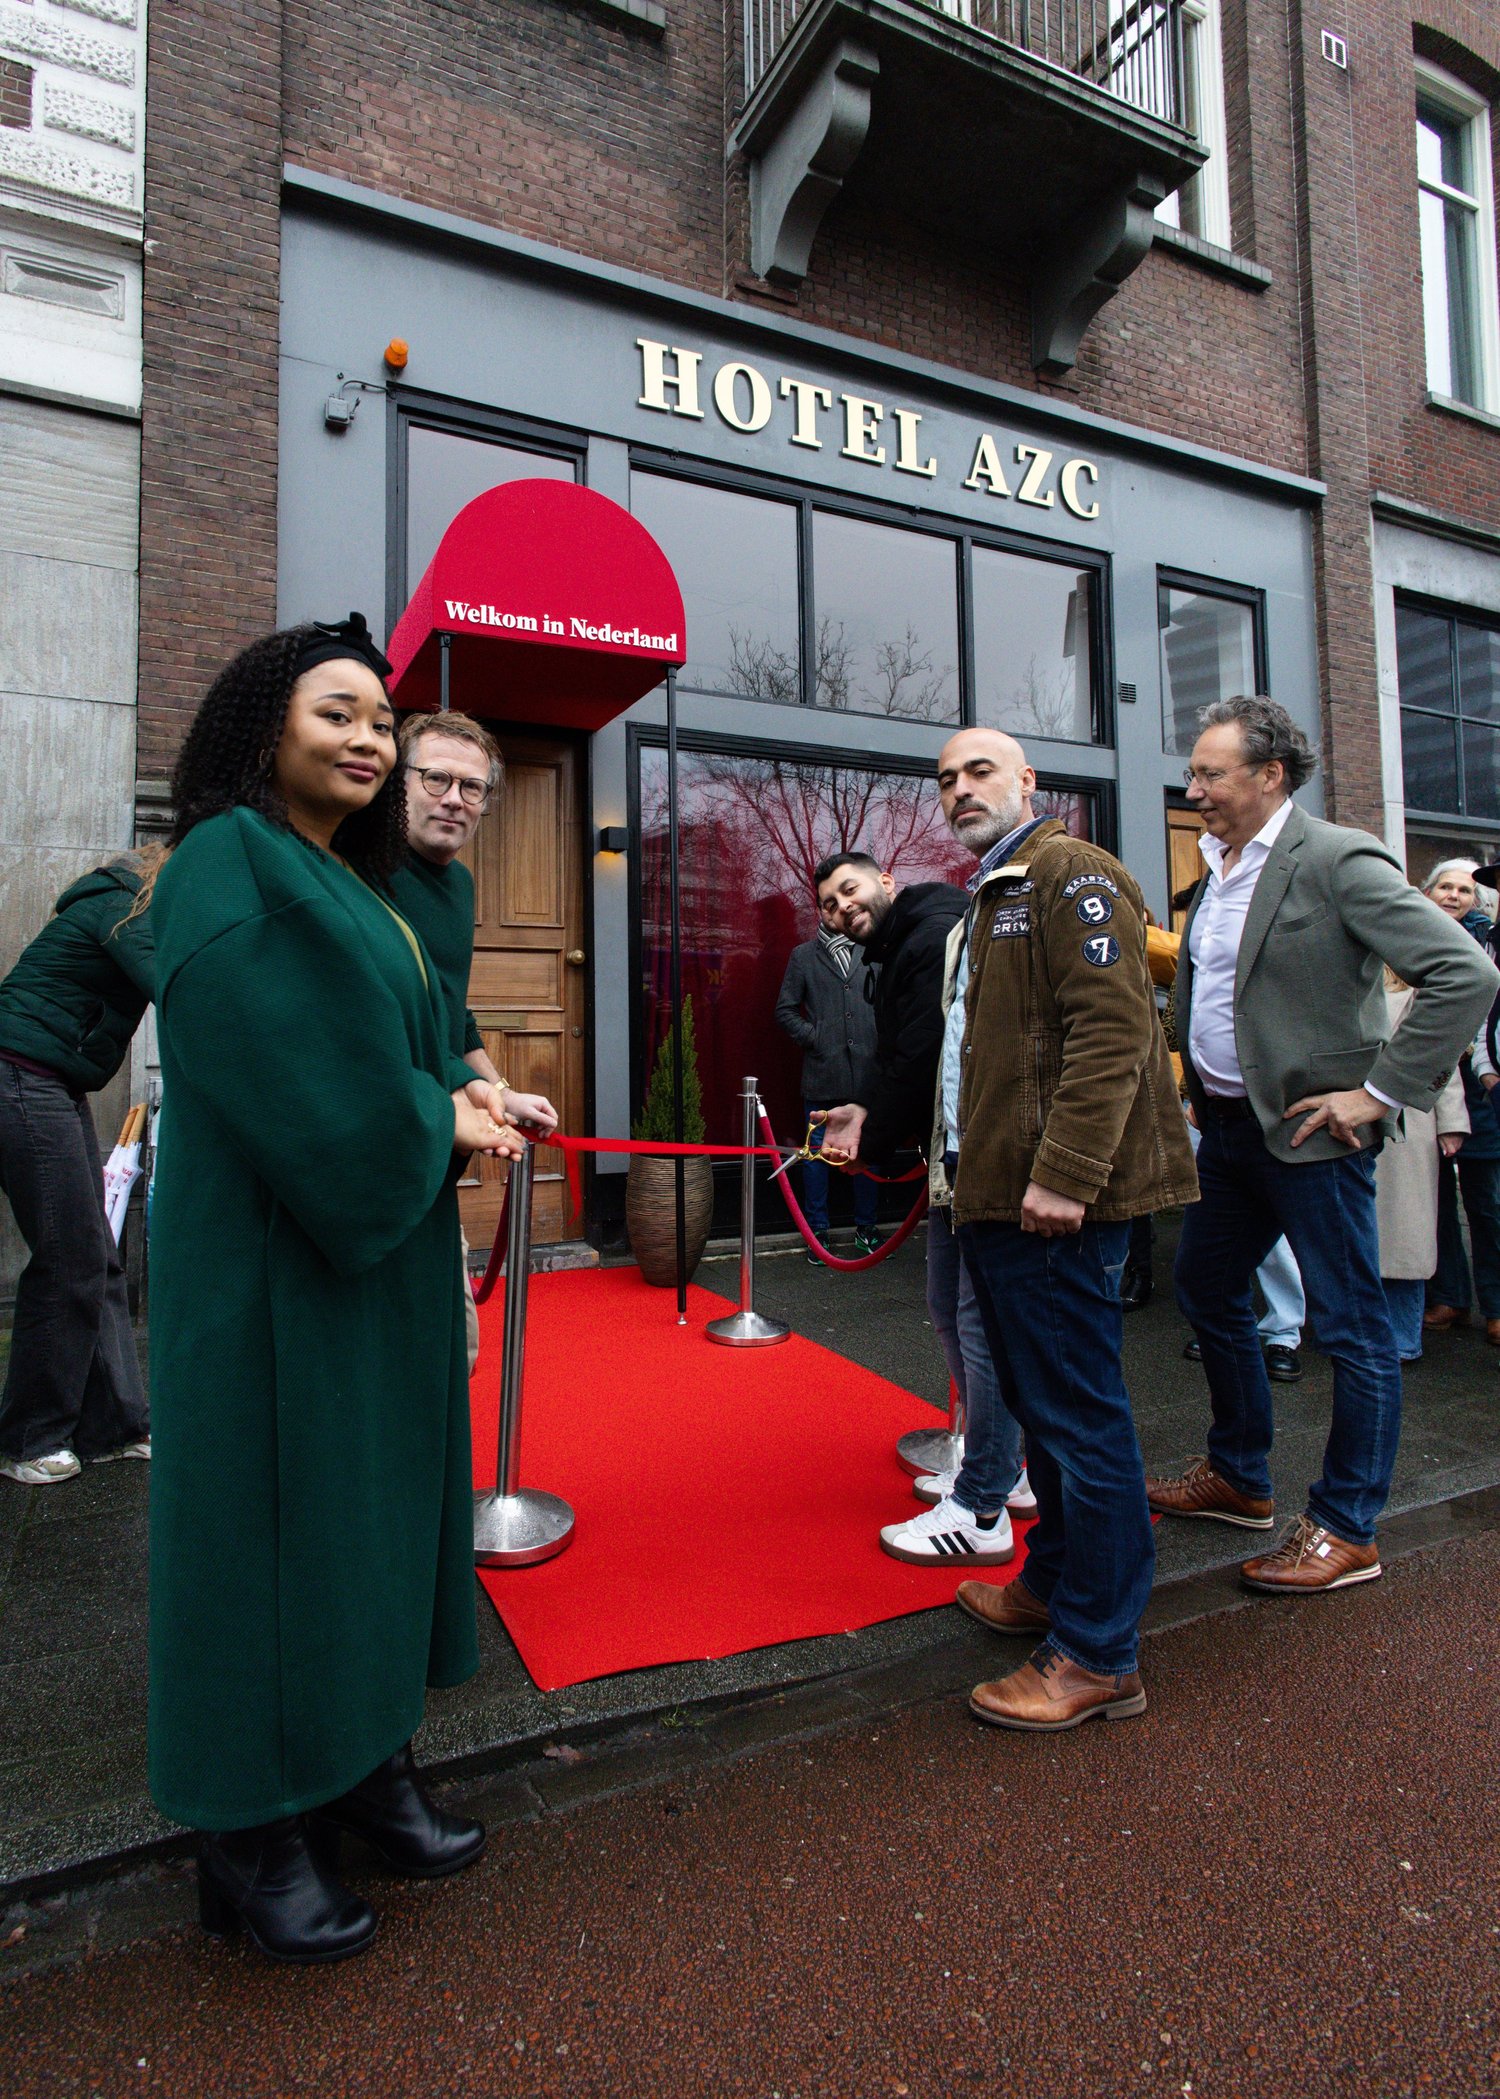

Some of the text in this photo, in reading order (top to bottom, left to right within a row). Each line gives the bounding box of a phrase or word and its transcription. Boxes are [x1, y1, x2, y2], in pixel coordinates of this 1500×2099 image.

[635, 337, 1101, 520] HOTEL AZC
[444, 599, 678, 652] Welkom in Nederland
[1084, 897, 1104, 921] 9
[993, 921, 1031, 934] CREW
[1090, 937, 1109, 962] 7
